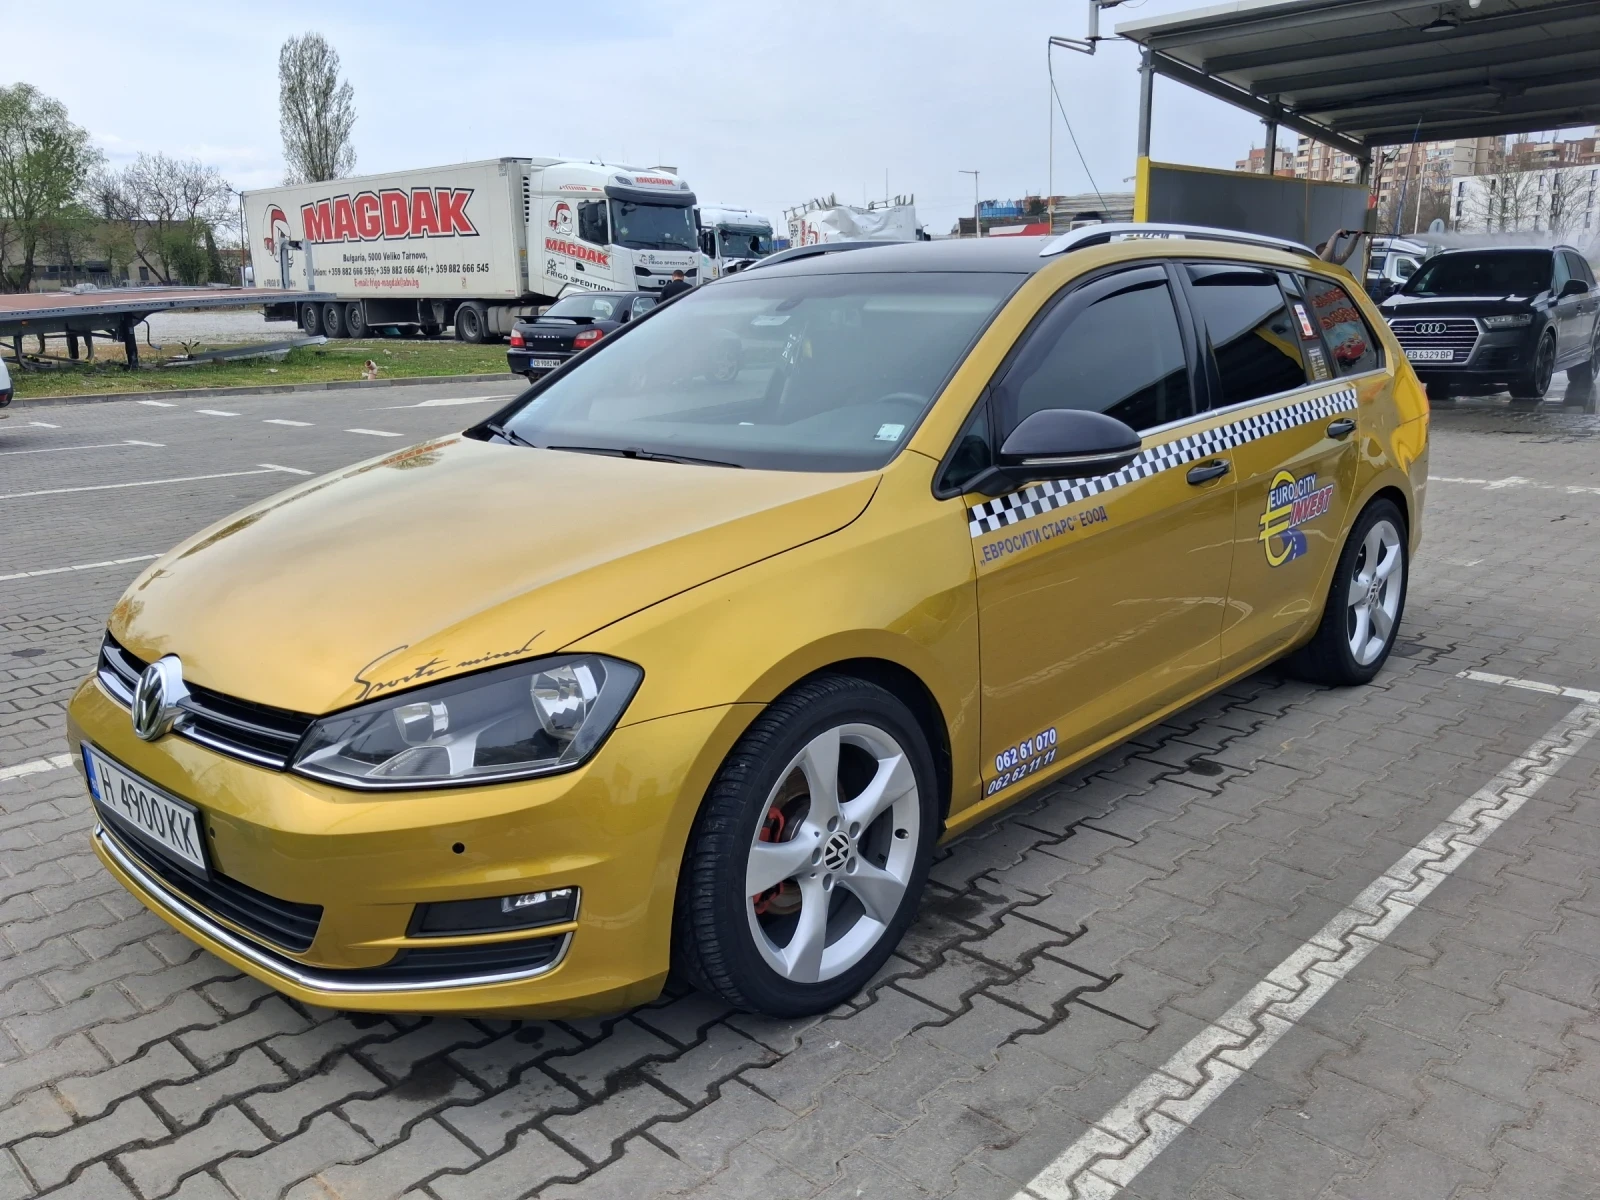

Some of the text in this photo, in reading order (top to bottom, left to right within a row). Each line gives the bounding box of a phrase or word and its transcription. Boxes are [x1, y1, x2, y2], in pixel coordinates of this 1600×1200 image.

[301, 187, 480, 244] MAGDAK
[343, 251, 428, 264] Bulgaria, 5000 Veliko Tarnovo,
[545, 238, 611, 267] MAGDAK
[436, 264, 448, 274] 359
[448, 263, 461, 273] 882
[462, 263, 475, 273] 666
[476, 262, 490, 273] 545
[546, 270, 569, 281] FRIGO
[1269, 483, 1295, 509] EURO
[1288, 484, 1334, 529] INVEST
[1079, 505, 1108, 527] ЕООД
[995, 727, 1057, 772] 062 61 070
[987, 748, 1057, 795] 062 62 11 11
